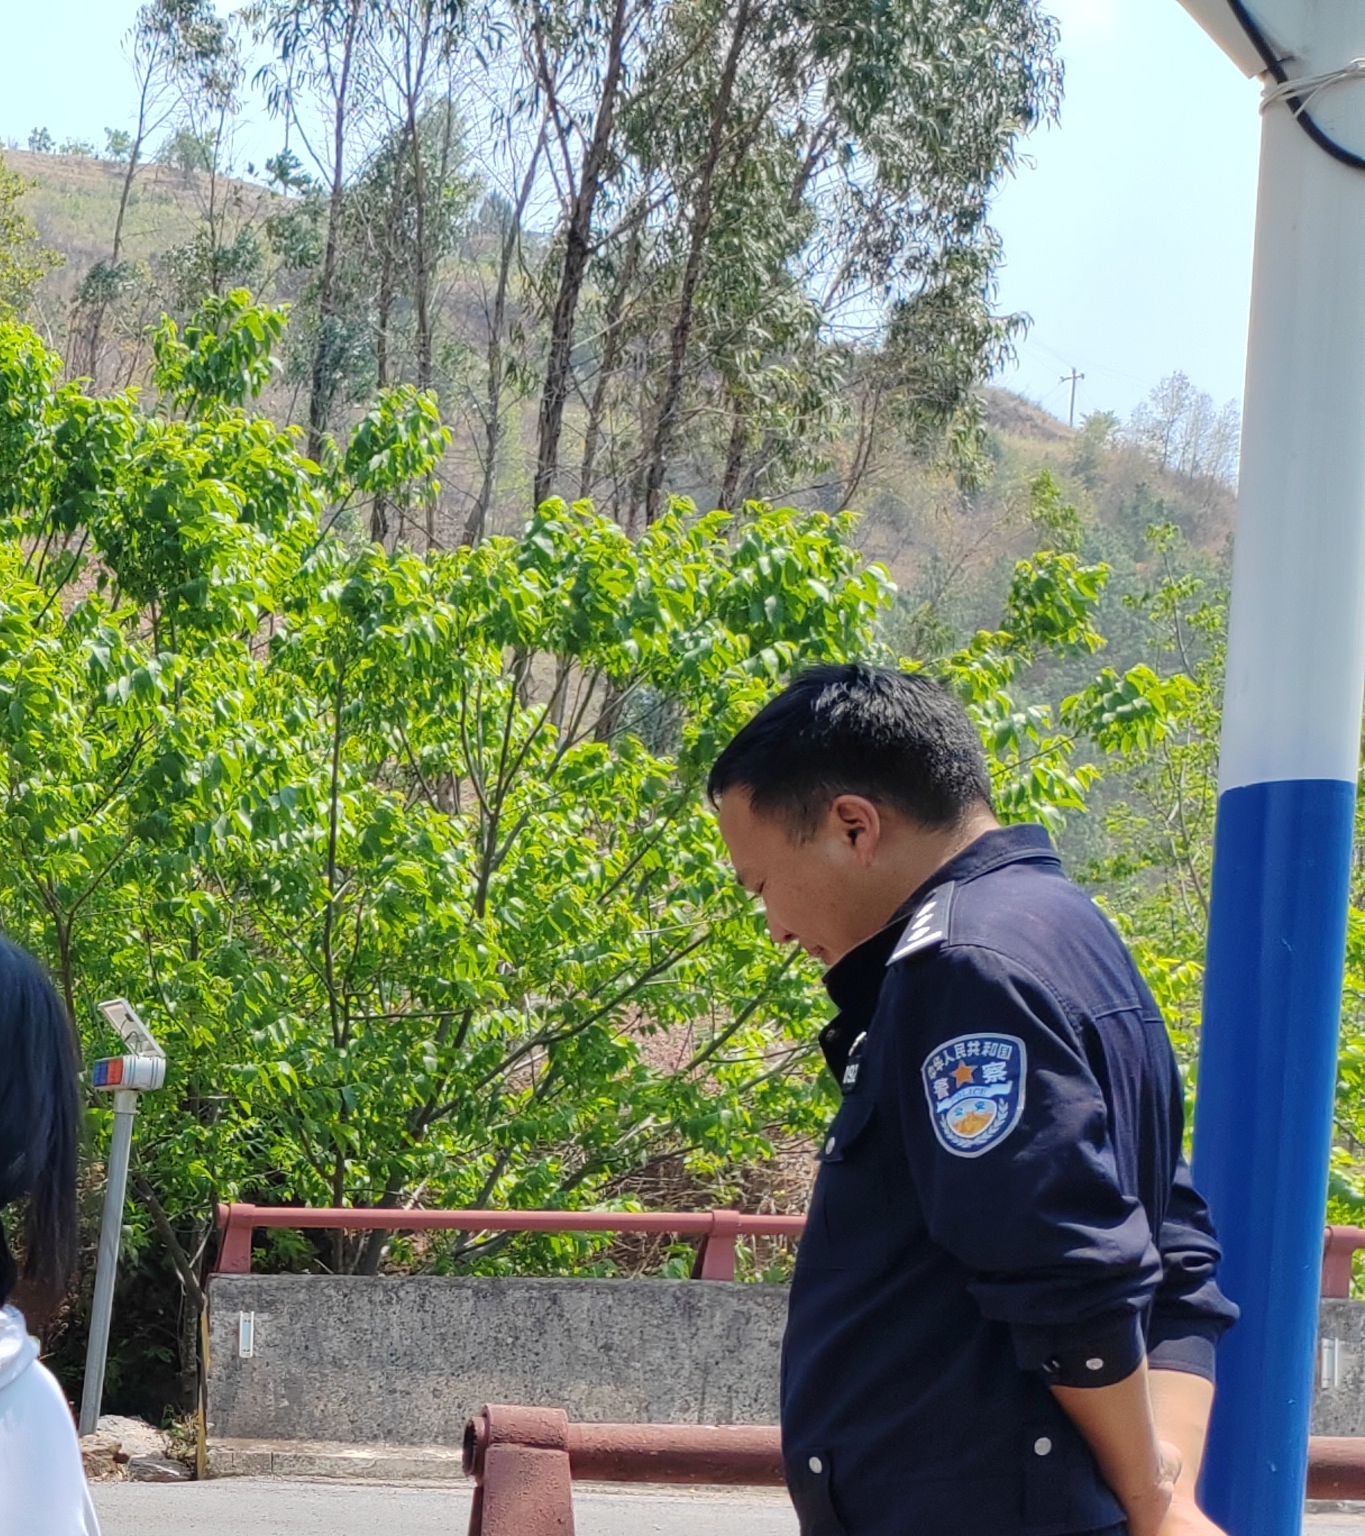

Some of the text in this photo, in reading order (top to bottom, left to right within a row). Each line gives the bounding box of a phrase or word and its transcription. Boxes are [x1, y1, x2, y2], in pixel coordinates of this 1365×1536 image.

[927, 1041, 1013, 1080] 中华人民共和国
